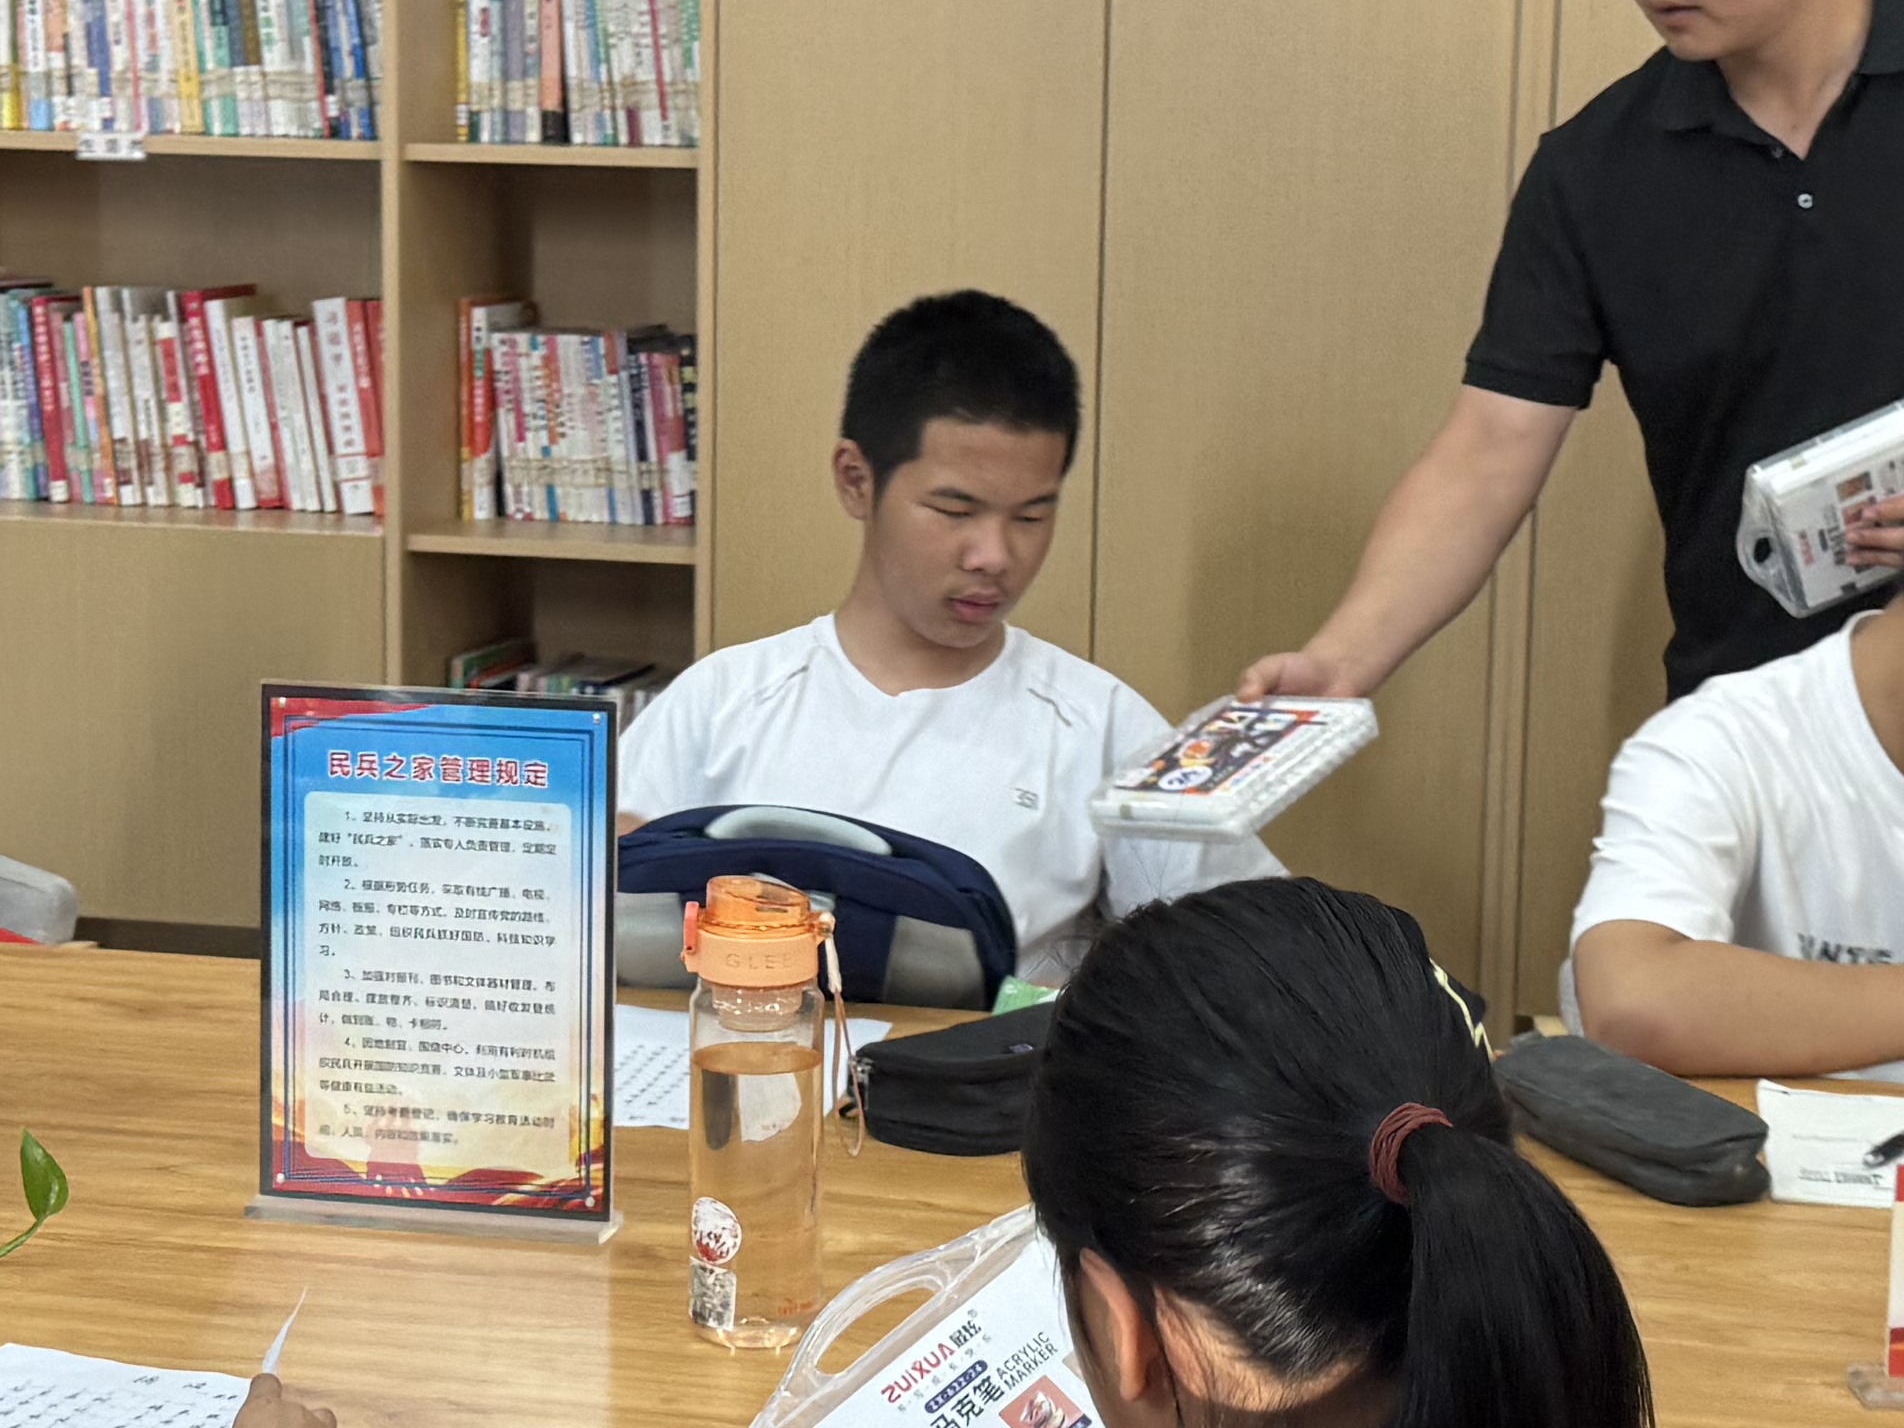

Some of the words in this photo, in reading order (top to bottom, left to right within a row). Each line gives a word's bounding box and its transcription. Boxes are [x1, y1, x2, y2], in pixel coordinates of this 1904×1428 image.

[327, 749, 549, 789] 民兵之家管理规定
[995, 1330, 1051, 1381] ACRYLIC
[1002, 1341, 1059, 1391] MARKER
